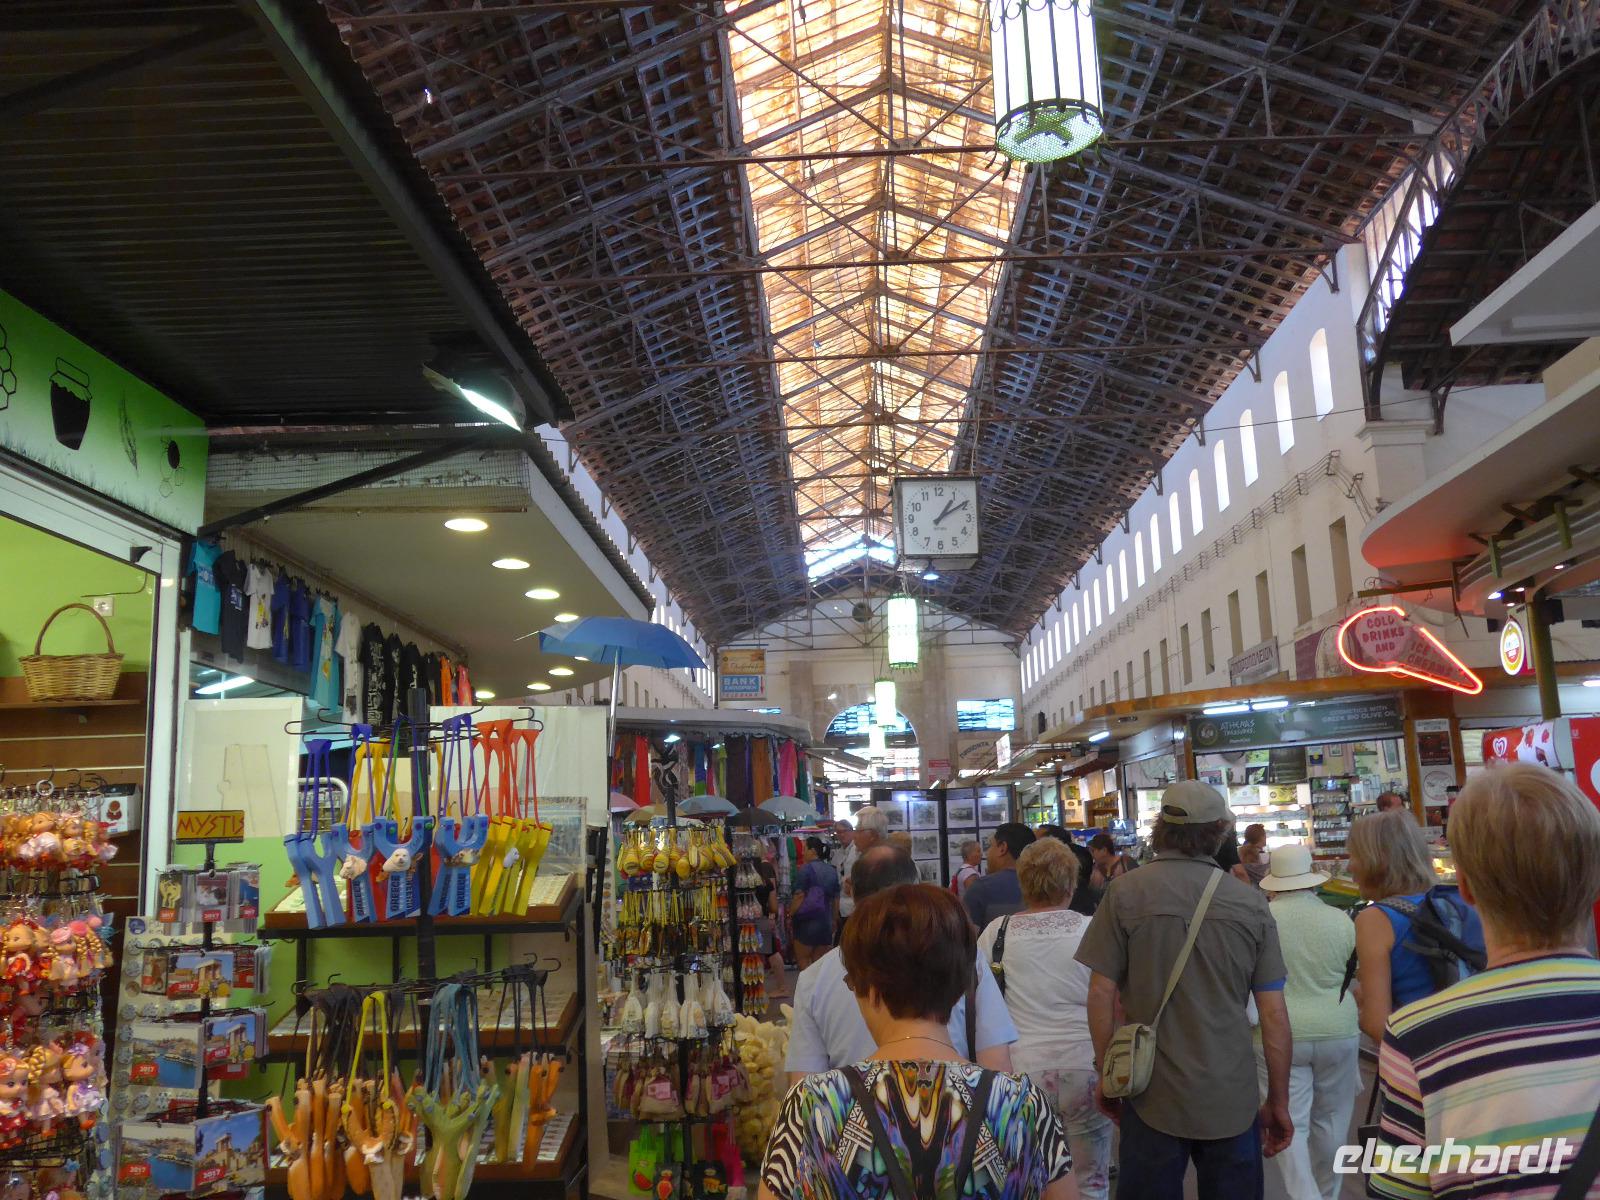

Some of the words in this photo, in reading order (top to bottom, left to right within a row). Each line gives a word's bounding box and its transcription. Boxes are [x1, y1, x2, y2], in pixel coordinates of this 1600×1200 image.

[921, 492, 929, 501] 11
[934, 487, 944, 496] 12
[911, 502, 921, 512] 10
[908, 514, 914, 523] 9
[966, 514, 972, 523] 3
[912, 527, 918, 536] 8
[961, 526, 968, 535] 4
[924, 537, 930, 547] 7
[938, 540, 943, 550] 6
[951, 537, 958, 546] 5
[1367, 616, 1395, 629] COLD
[1362, 626, 1405, 642] DRINKS
[1375, 642, 1395, 653] AND
[723, 677, 757, 687] BANK
[390, 875, 400, 912] GREECE
[456, 873, 466, 909] GREECE
[203, 1170, 221, 1179] 2017
